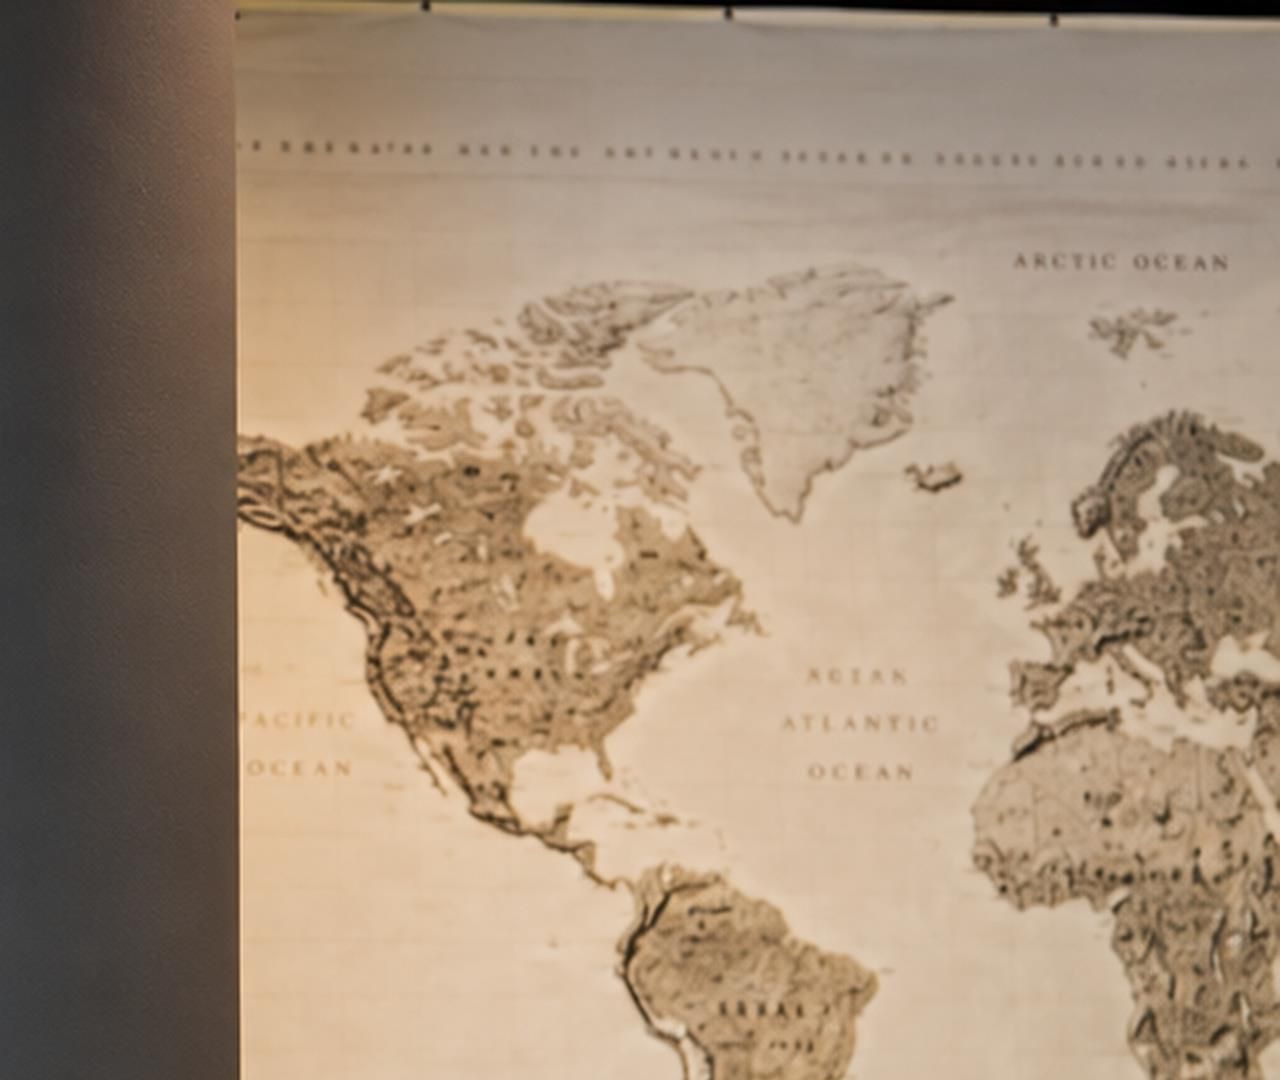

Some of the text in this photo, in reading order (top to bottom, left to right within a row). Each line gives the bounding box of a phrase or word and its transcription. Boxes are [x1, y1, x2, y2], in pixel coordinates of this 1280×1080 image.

[1014, 252, 1229, 272] ARCTIC OCEAN
[782, 713, 939, 734] ATLANTIC
[246, 758, 352, 777] OCEAN
[807, 763, 913, 782] OCEAN
